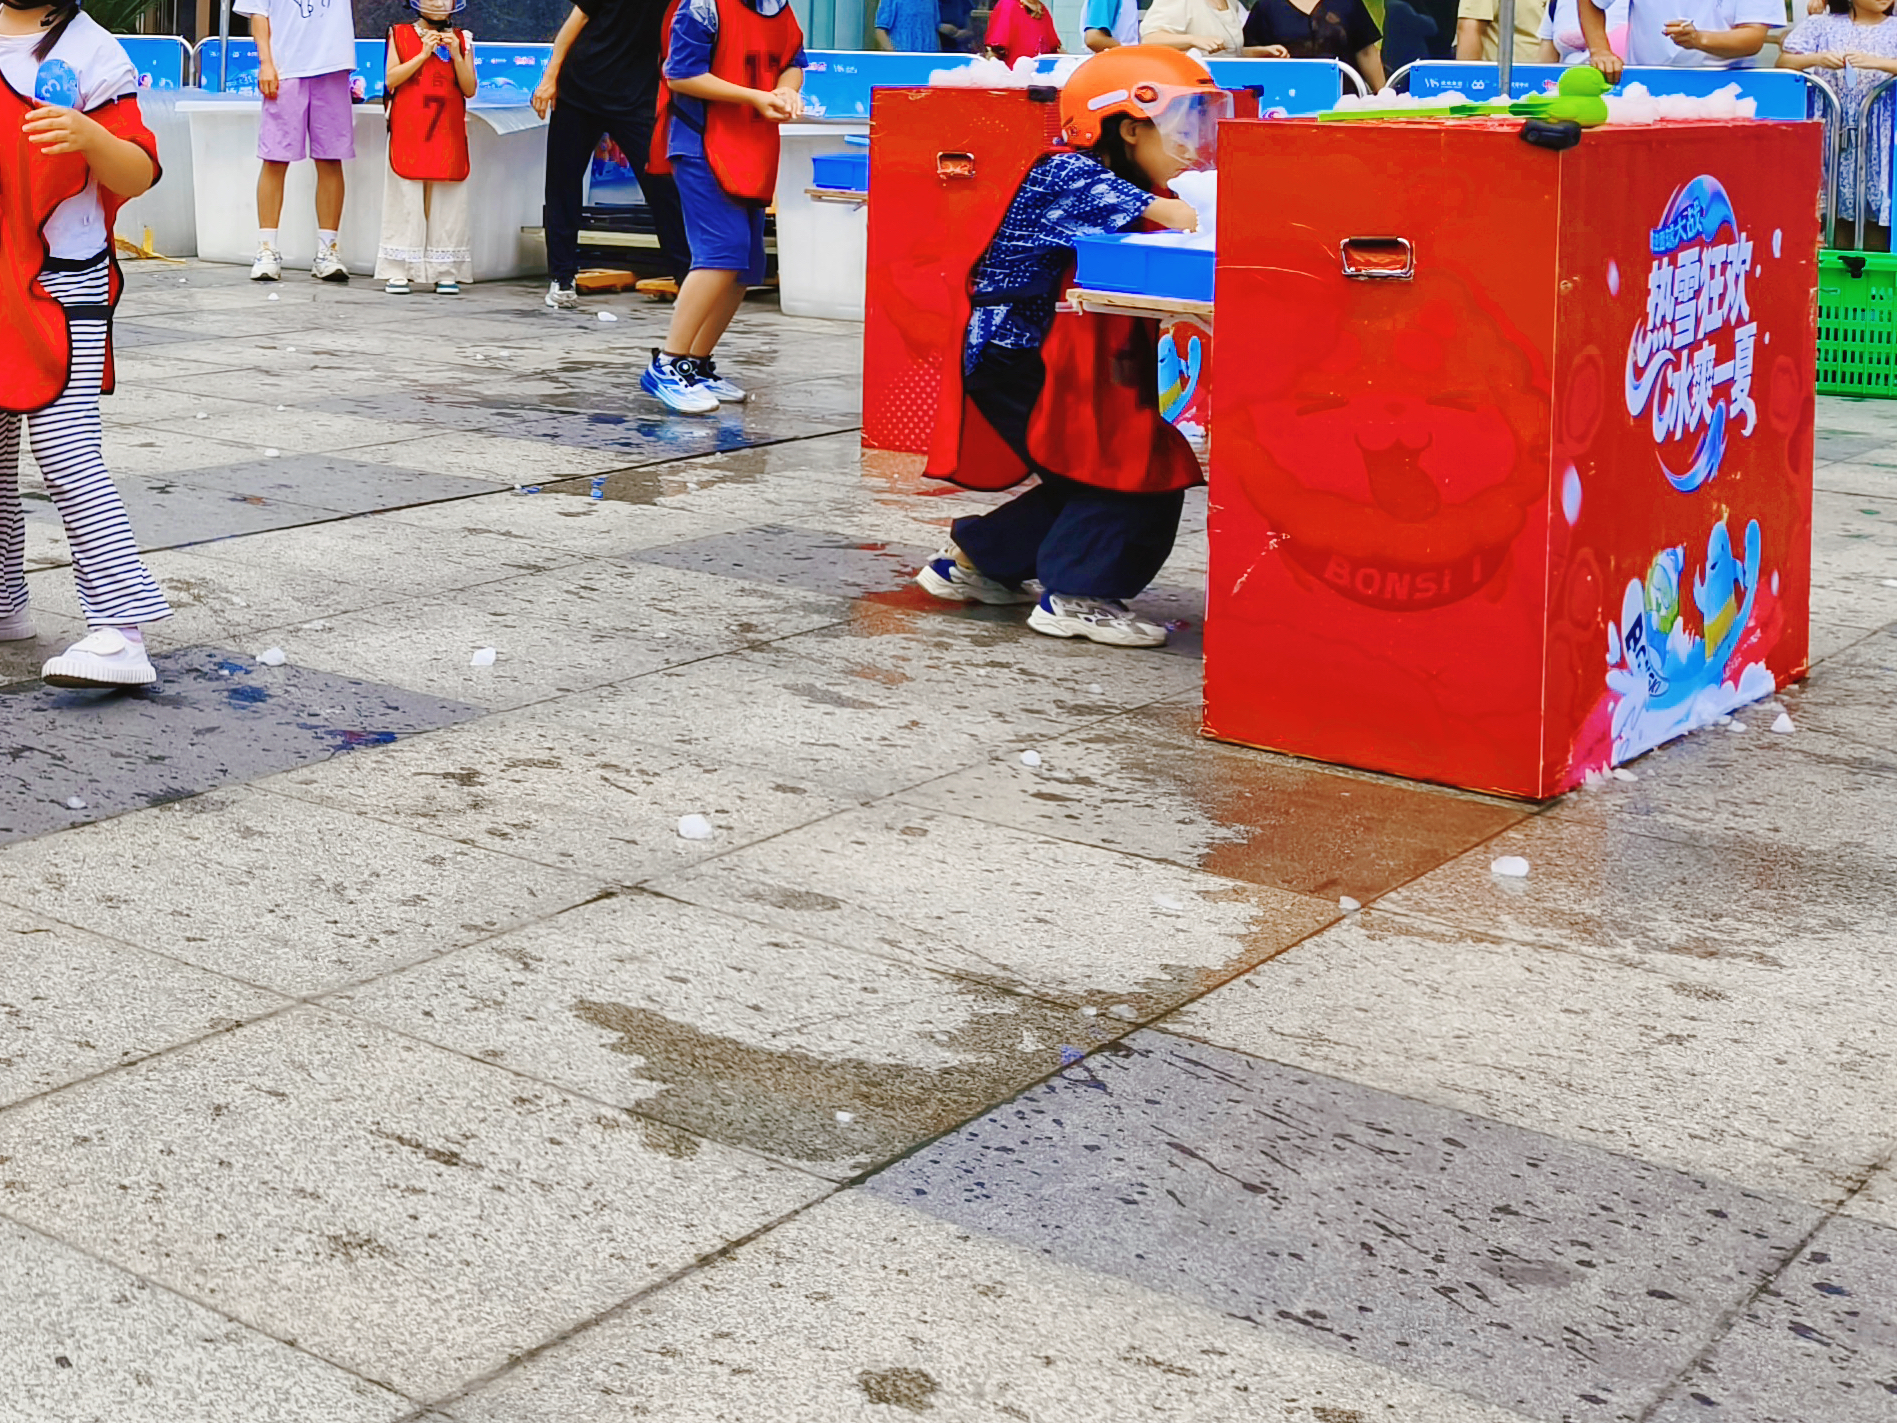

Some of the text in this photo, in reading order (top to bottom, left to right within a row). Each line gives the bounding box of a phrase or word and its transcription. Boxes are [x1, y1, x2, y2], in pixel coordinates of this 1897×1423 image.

[423, 94, 446, 143] 7
[1639, 232, 1754, 363] 热雪狂欢
[1653, 321, 1758, 444] 冰爽一夏
[1322, 554, 1482, 600] BONSI
